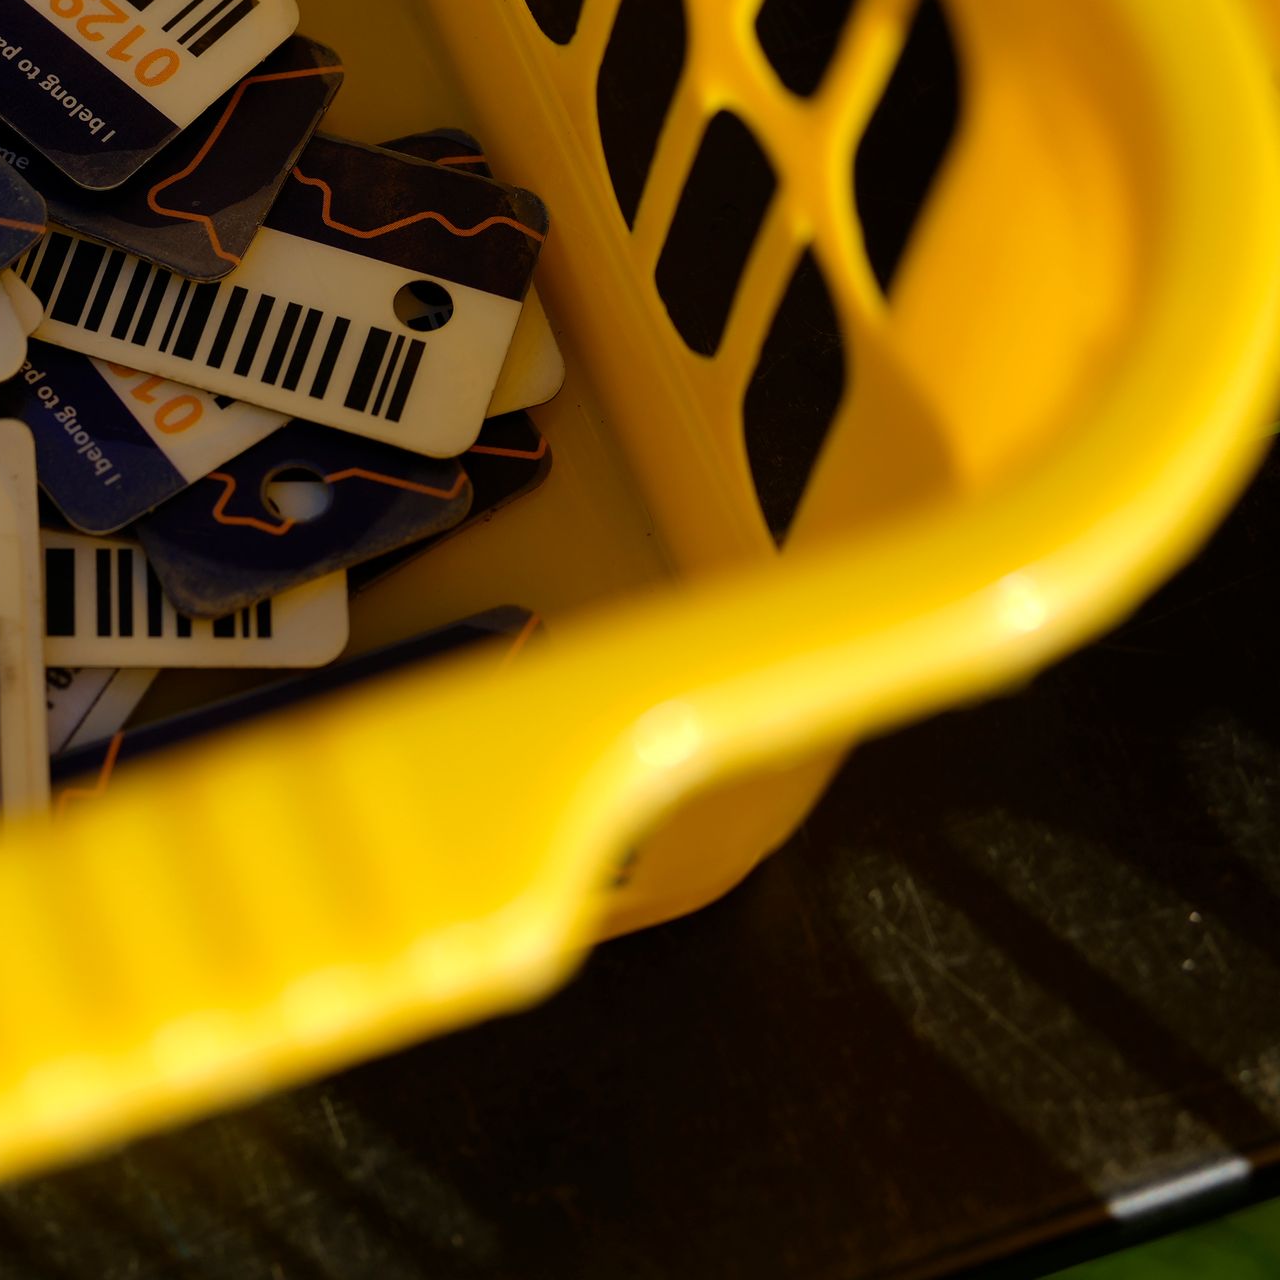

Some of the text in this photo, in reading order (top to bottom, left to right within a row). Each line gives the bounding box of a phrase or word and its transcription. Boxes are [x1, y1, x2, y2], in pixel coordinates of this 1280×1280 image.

[17, 58, 42, 81] to
[39, 74, 107, 136] belong
[36, 385, 61, 410] to
[53, 405, 114, 477] belong
